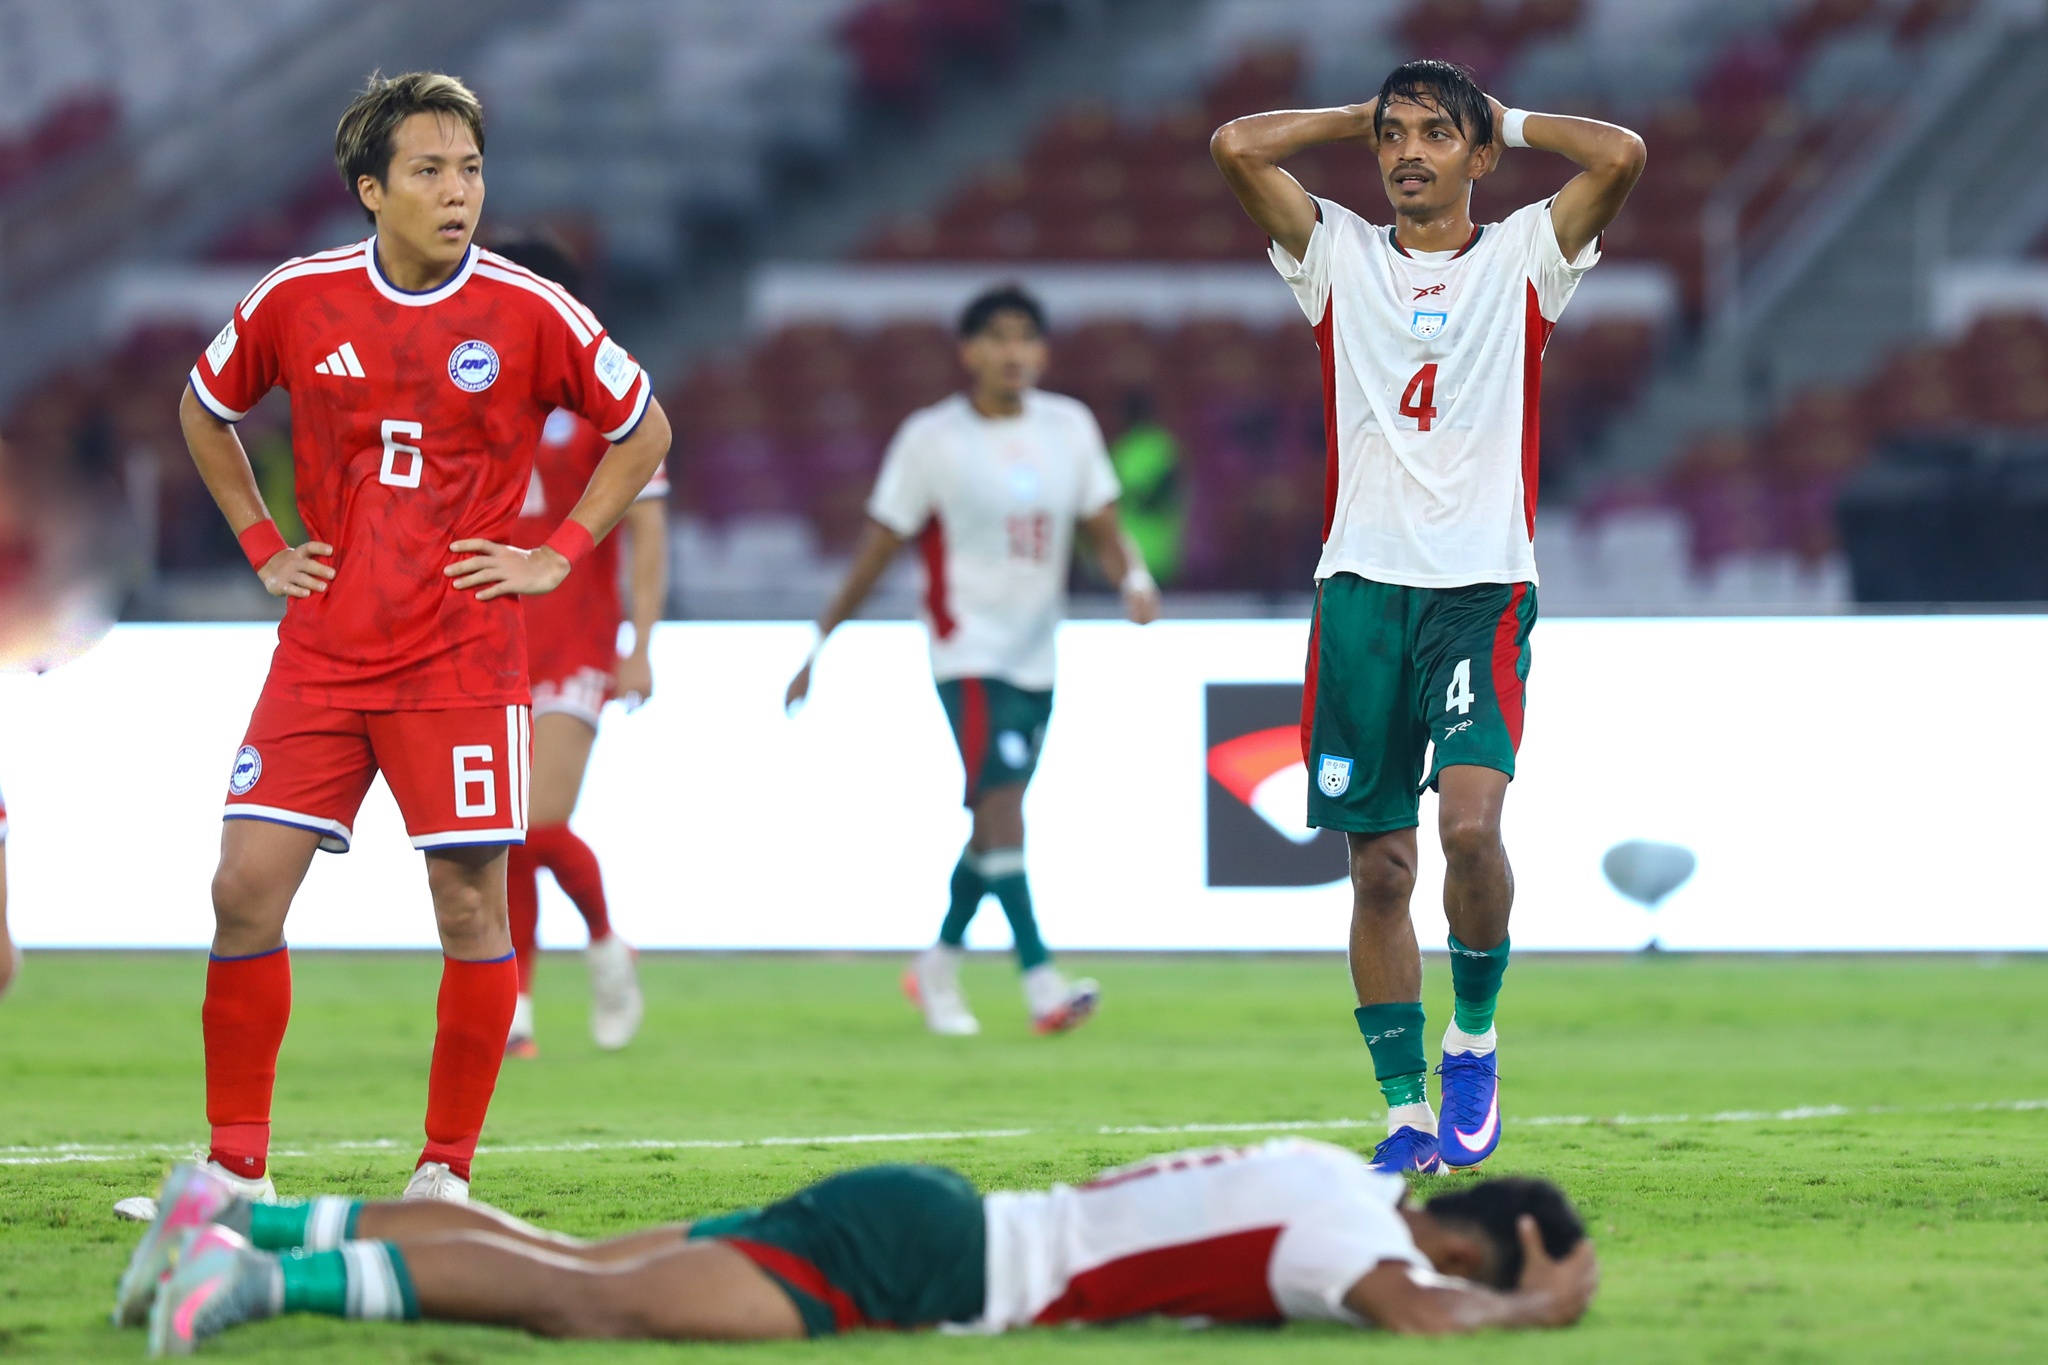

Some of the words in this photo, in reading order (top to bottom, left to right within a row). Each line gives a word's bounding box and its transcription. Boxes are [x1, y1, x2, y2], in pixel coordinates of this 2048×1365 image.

[1399, 363, 1437, 431] 4
[379, 420, 422, 488] 6
[1446, 659, 1474, 715] 4
[453, 745, 496, 817] 6
